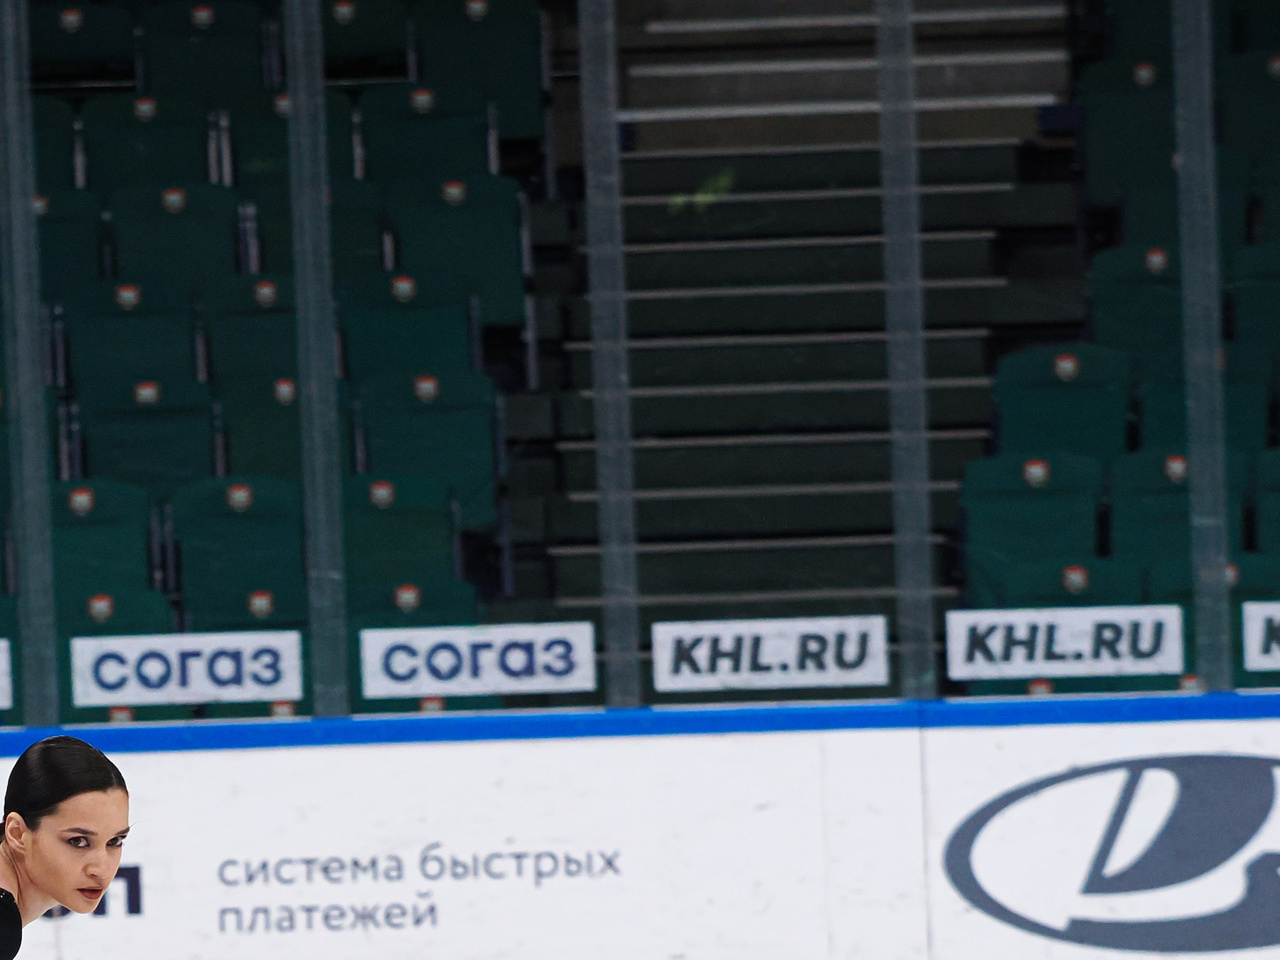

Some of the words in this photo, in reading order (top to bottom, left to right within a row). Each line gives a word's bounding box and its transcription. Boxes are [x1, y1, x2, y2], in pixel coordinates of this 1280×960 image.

[671, 631, 870, 676] KHL.RU
[964, 620, 1165, 664] KHL.RU
[216, 854, 405, 887] система
[418, 842, 621, 887] быстрых
[218, 892, 438, 934] платежей
